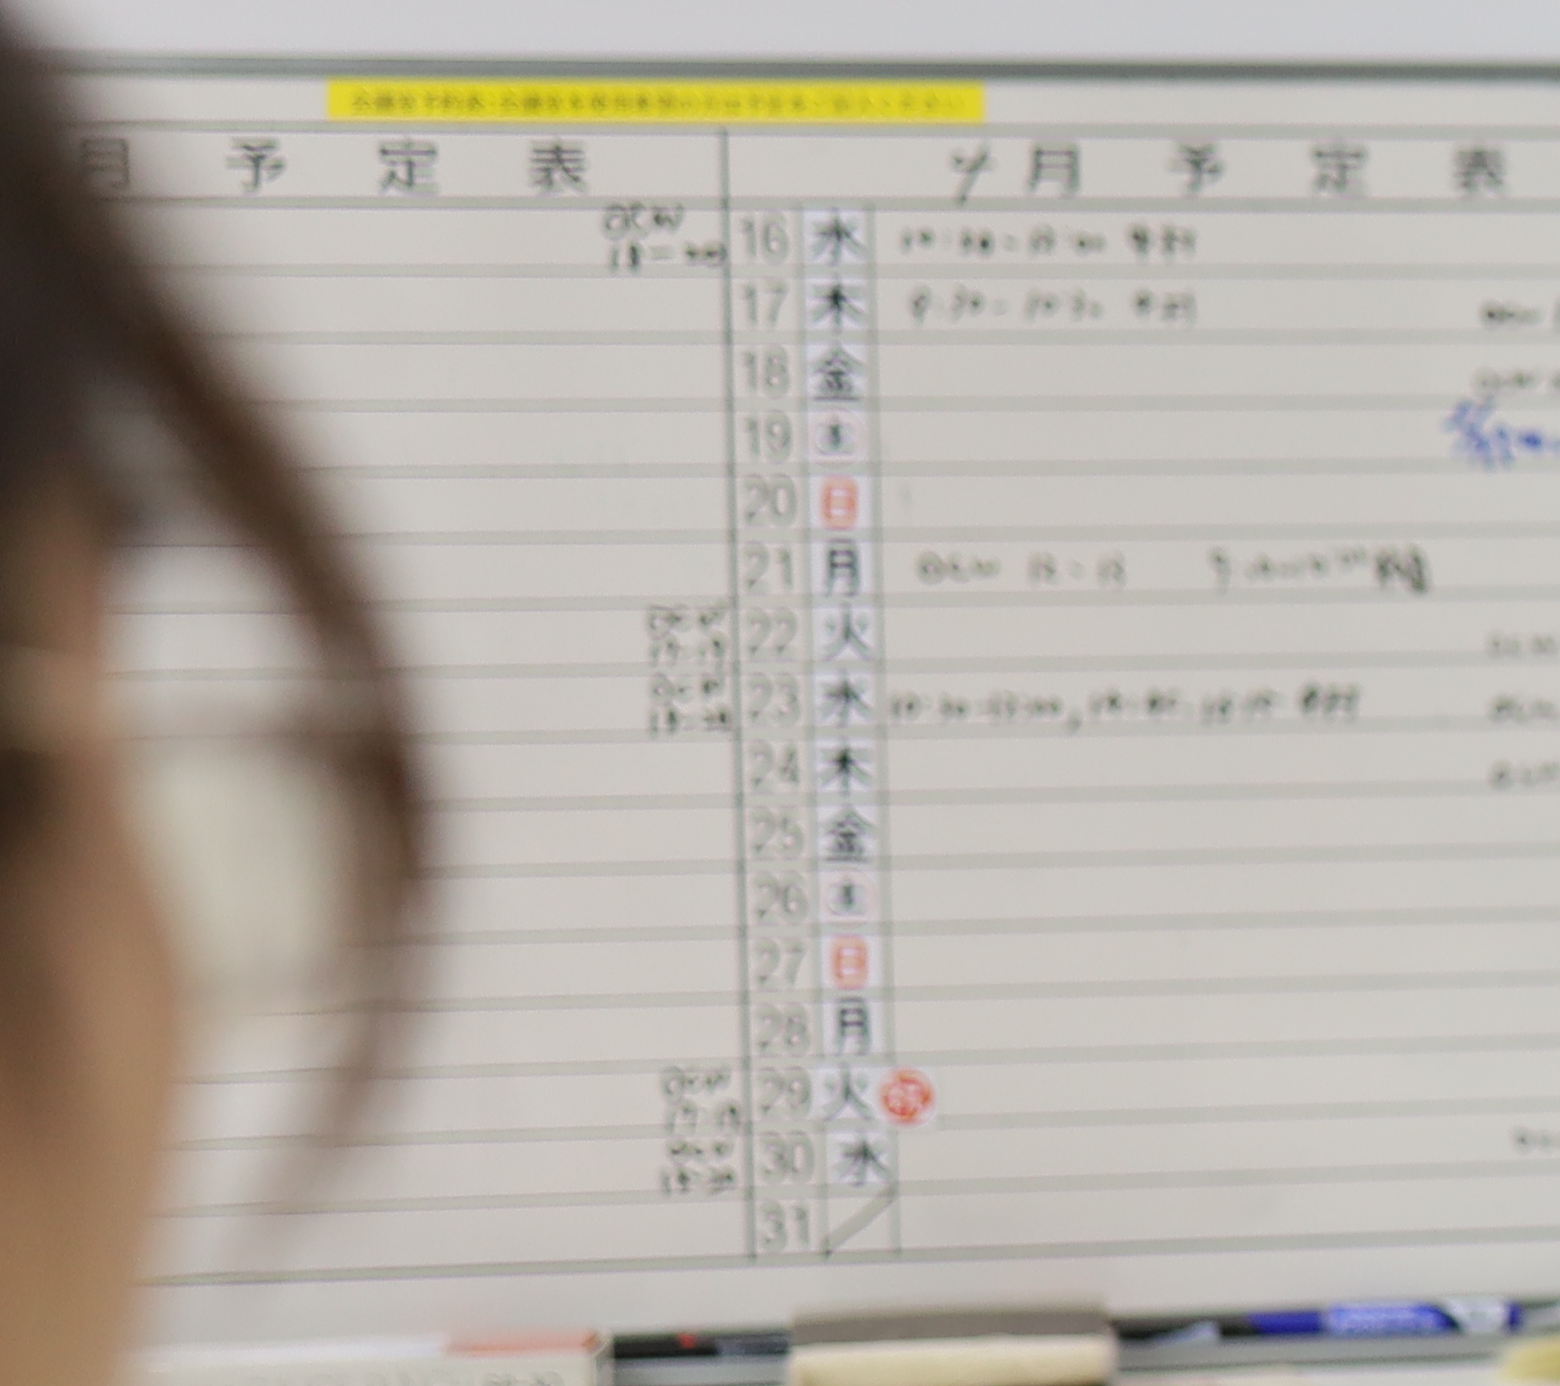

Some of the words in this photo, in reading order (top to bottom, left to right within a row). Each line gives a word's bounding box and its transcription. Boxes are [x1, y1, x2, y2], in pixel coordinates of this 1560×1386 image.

[741, 217, 789, 264] 16
[809, 206, 866, 265] 水
[743, 278, 789, 328] 17
[810, 277, 866, 335] 木
[742, 344, 791, 398] 18
[810, 342, 866, 401] 金
[744, 409, 792, 464] 19
[743, 474, 798, 528] 20
[820, 475, 860, 530] 日
[743, 541, 792, 595] 21
[824, 539, 861, 597] 月
[747, 607, 797, 661] 22
[822, 603, 873, 661] 火
[748, 672, 799, 728] 23
[820, 671, 874, 727] 水
[749, 739, 799, 794] 24
[820, 741, 874, 795] 木
[750, 806, 803, 860] 25
[821, 808, 876, 863] 金
[751, 870, 808, 925] 26
[754, 938, 804, 991] 27
[830, 935, 868, 989] 日
[755, 1001, 810, 1057] 28
[835, 997, 871, 1055] 月
[757, 1066, 812, 1122] 29
[822, 1063, 873, 1122] 火
[758, 1131, 814, 1186] 30
[836, 1135, 890, 1186] 水
[759, 1198, 810, 1253] 31
